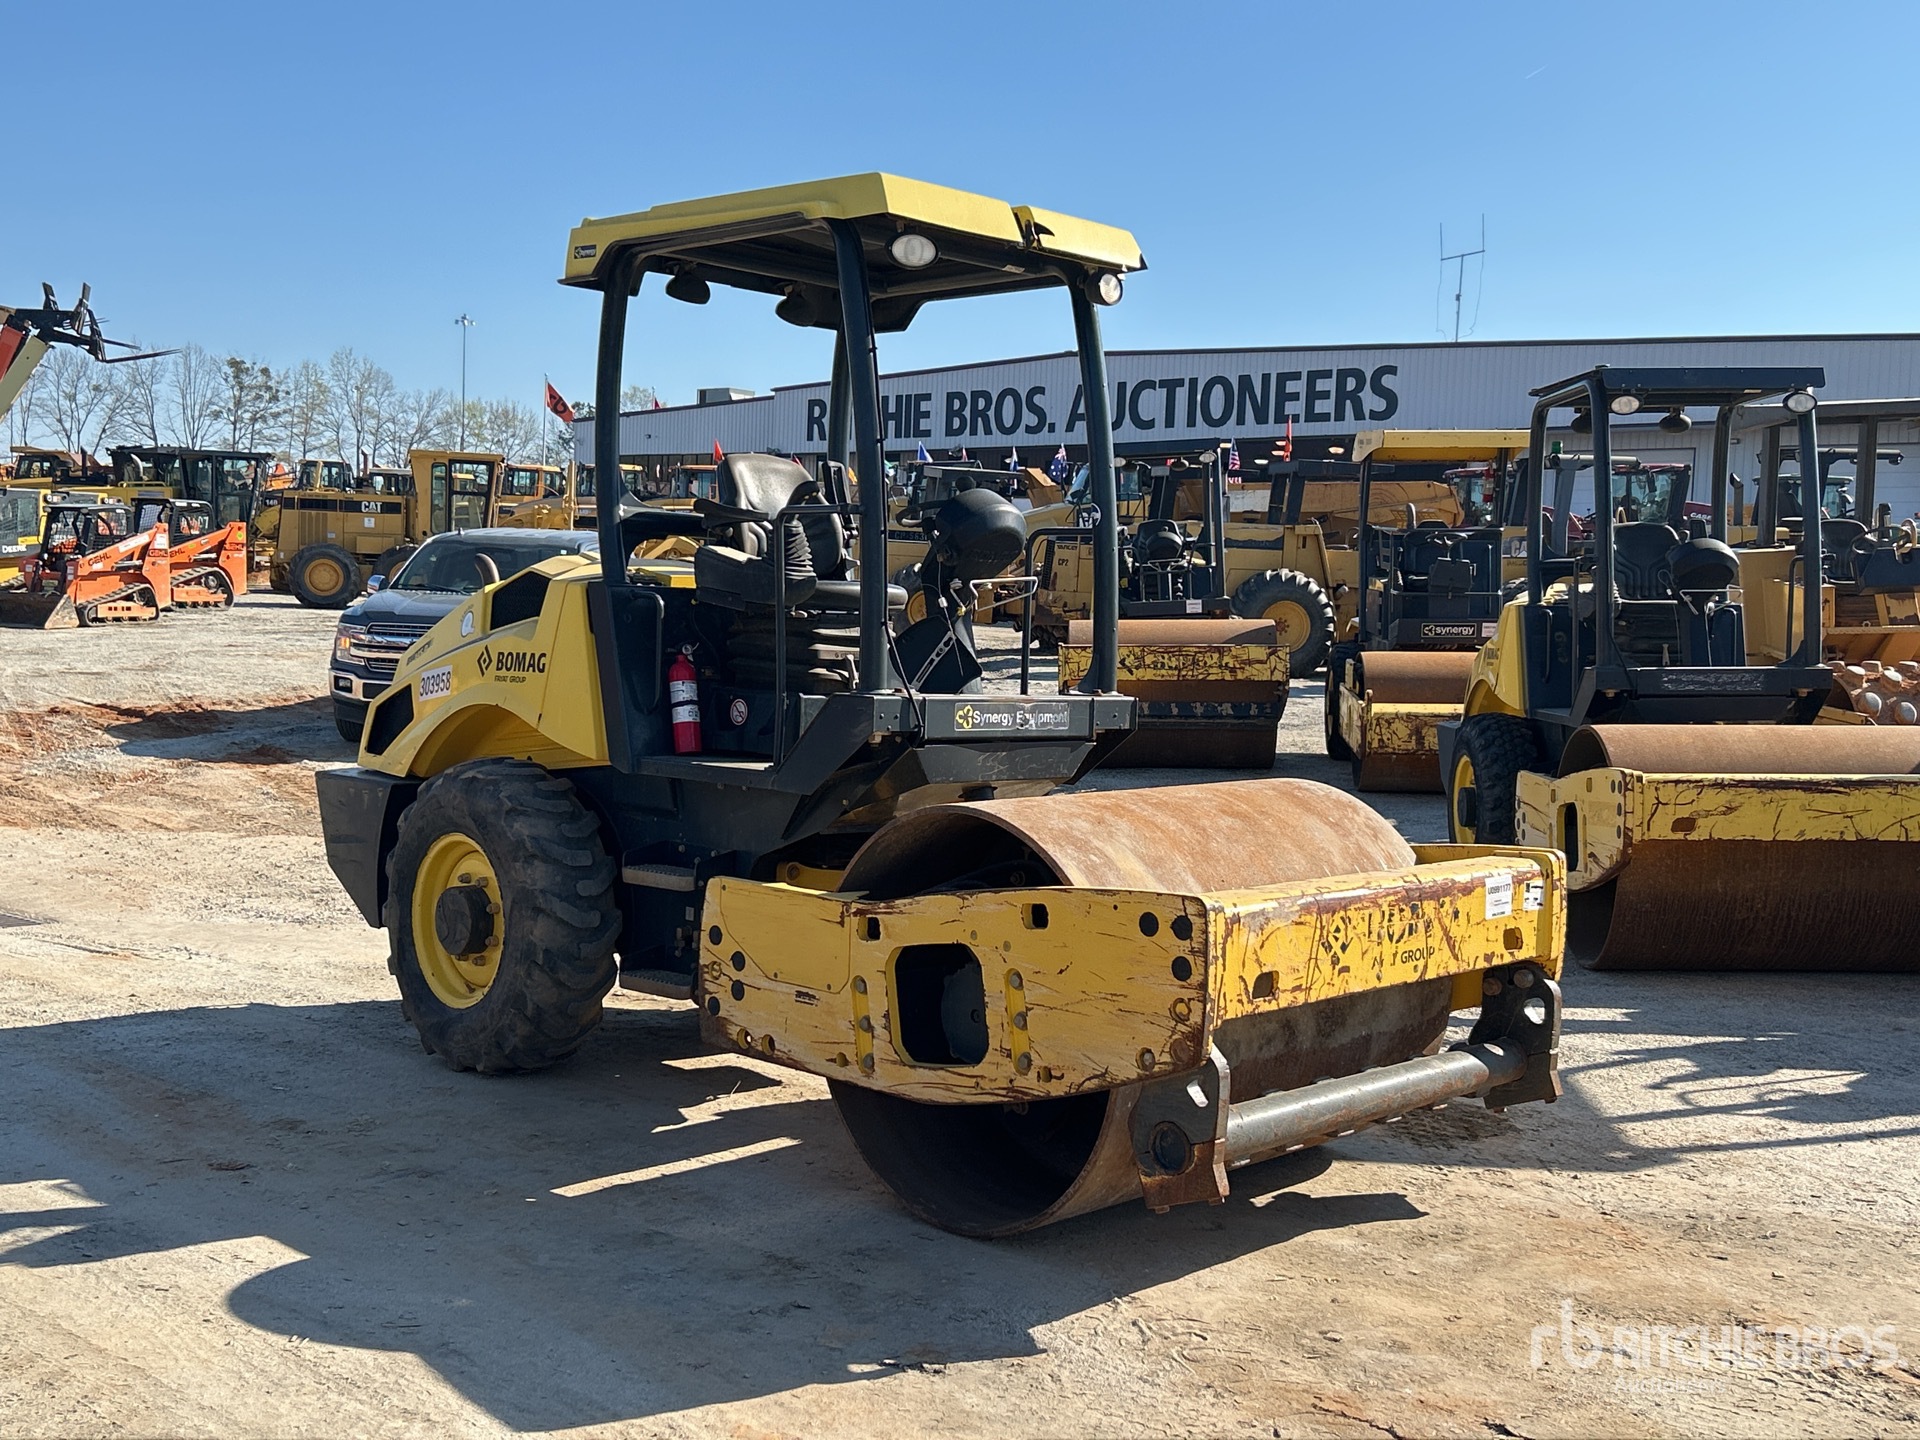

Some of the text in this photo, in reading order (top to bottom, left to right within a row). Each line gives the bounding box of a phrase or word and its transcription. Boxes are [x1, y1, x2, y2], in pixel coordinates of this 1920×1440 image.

[807, 392, 932, 442] RHIE
[945, 386, 1056, 437] BROS.
[361, 501, 382, 513] CAT
[169, 548, 185, 558] EHL
[1511, 540, 1528, 557] CA
[88, 552, 111, 567] GEHL
[1436, 627, 1474, 635] synergy
[495, 651, 547, 673] BOMAG
[420, 671, 451, 697] 303958
[509, 675, 526, 683] GROUP
[973, 710, 1013, 727] Synergy
[1400, 945, 1435, 965] GROUP
